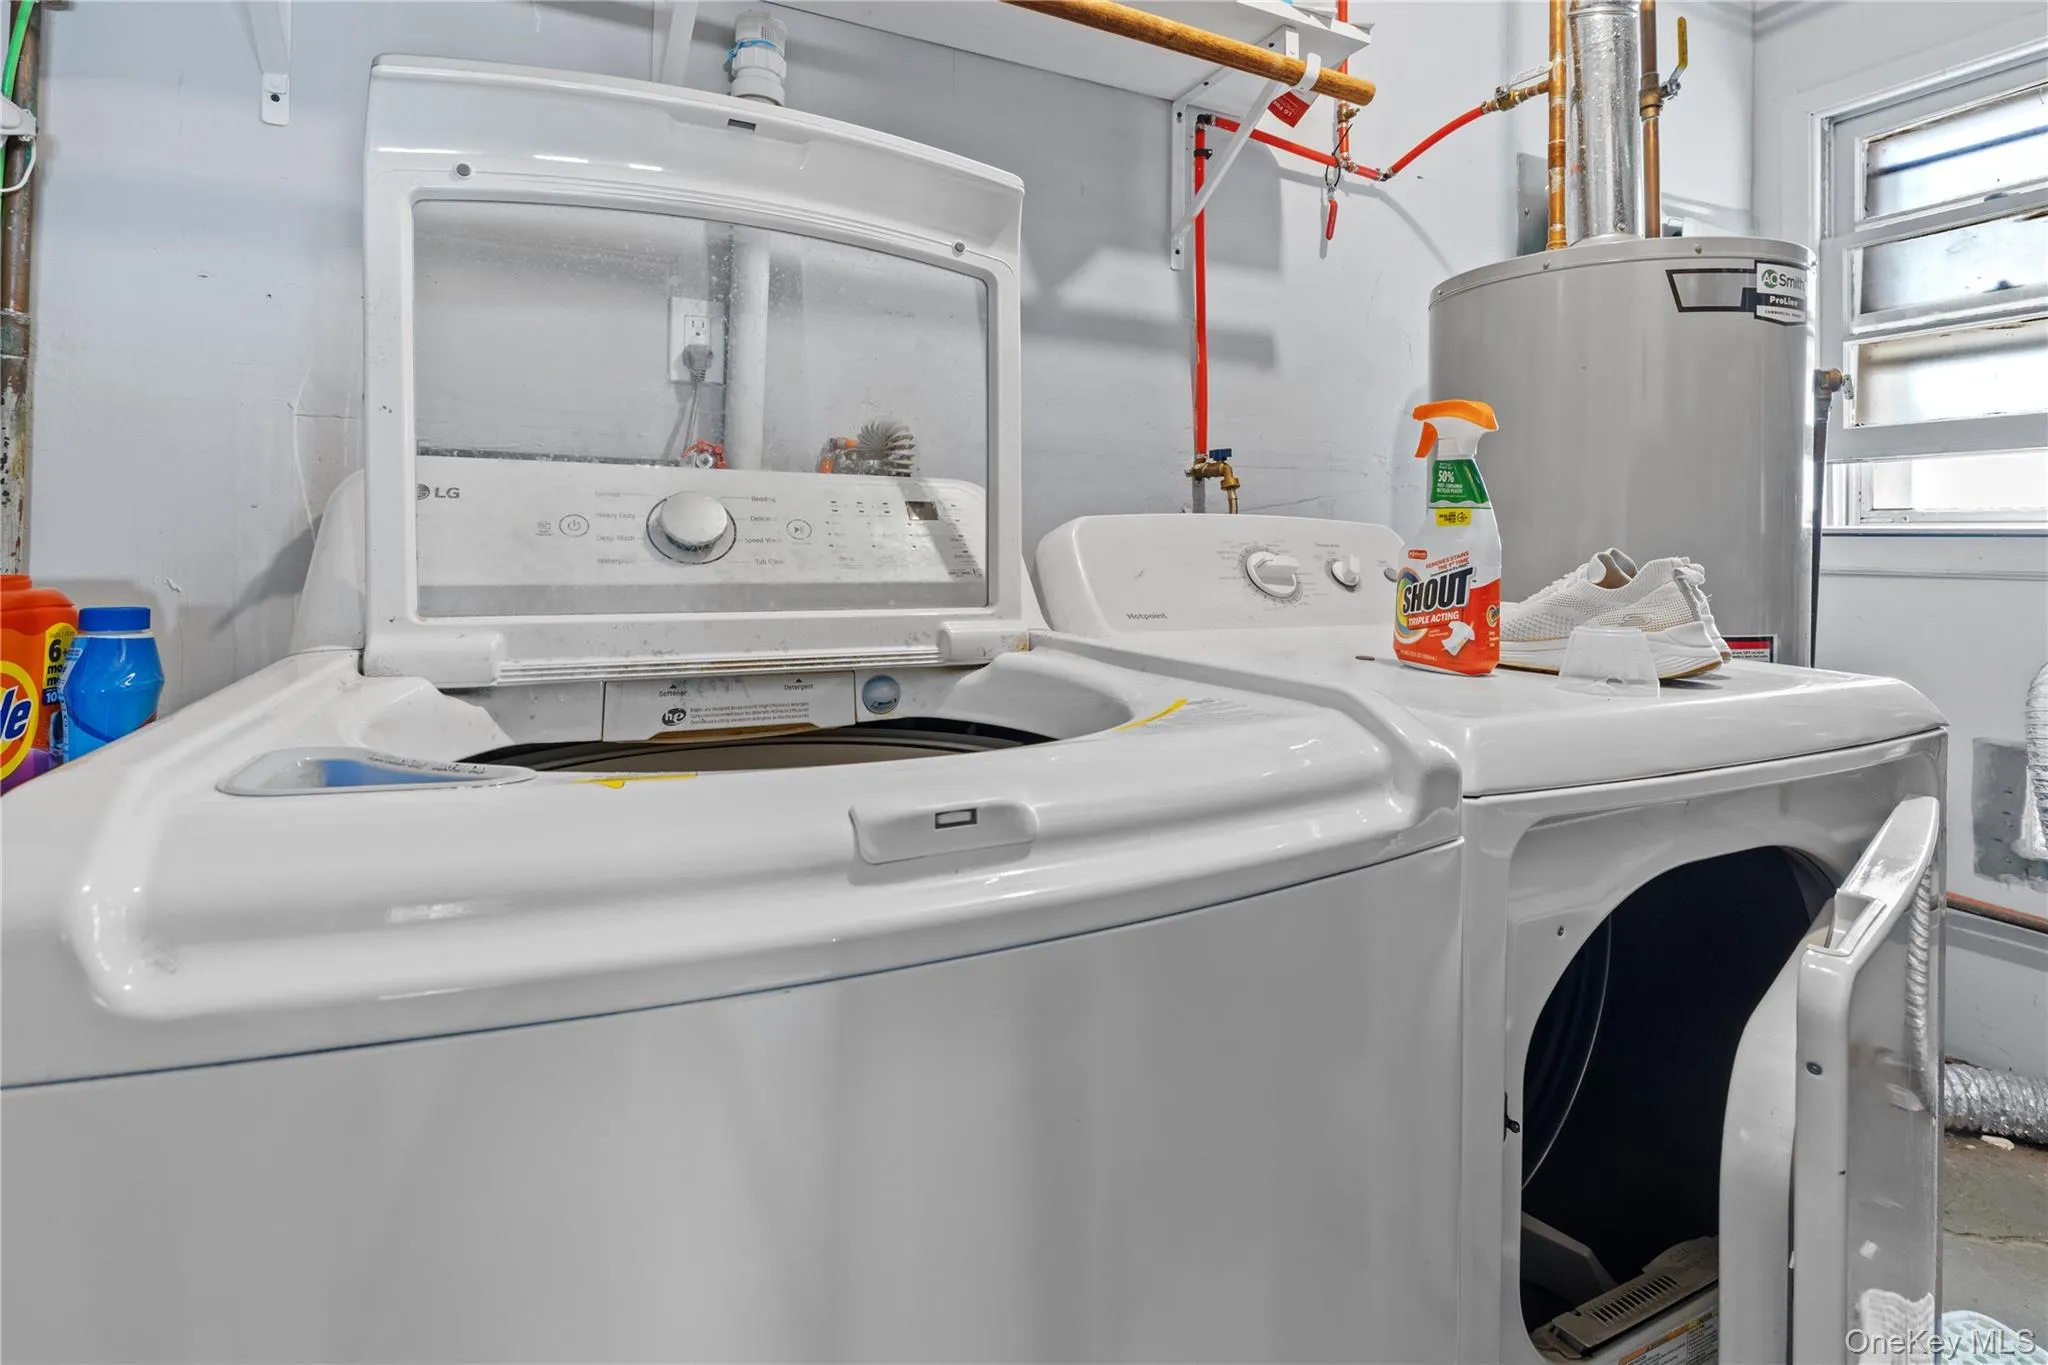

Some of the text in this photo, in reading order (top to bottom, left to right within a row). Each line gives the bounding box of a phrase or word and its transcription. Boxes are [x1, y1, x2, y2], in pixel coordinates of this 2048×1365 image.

[1769, 296, 1799, 306] ProLine
[1438, 471, 1455, 483] 50%
[434, 487, 460, 499] LG
[595, 512, 636, 520] Heavy Duty
[1403, 567, 1474, 614] SHOUT
[1126, 612, 1167, 621] Hotpoint
[1408, 610, 1460, 627] TRIPLE ACTING
[664, 708, 686, 725] he
